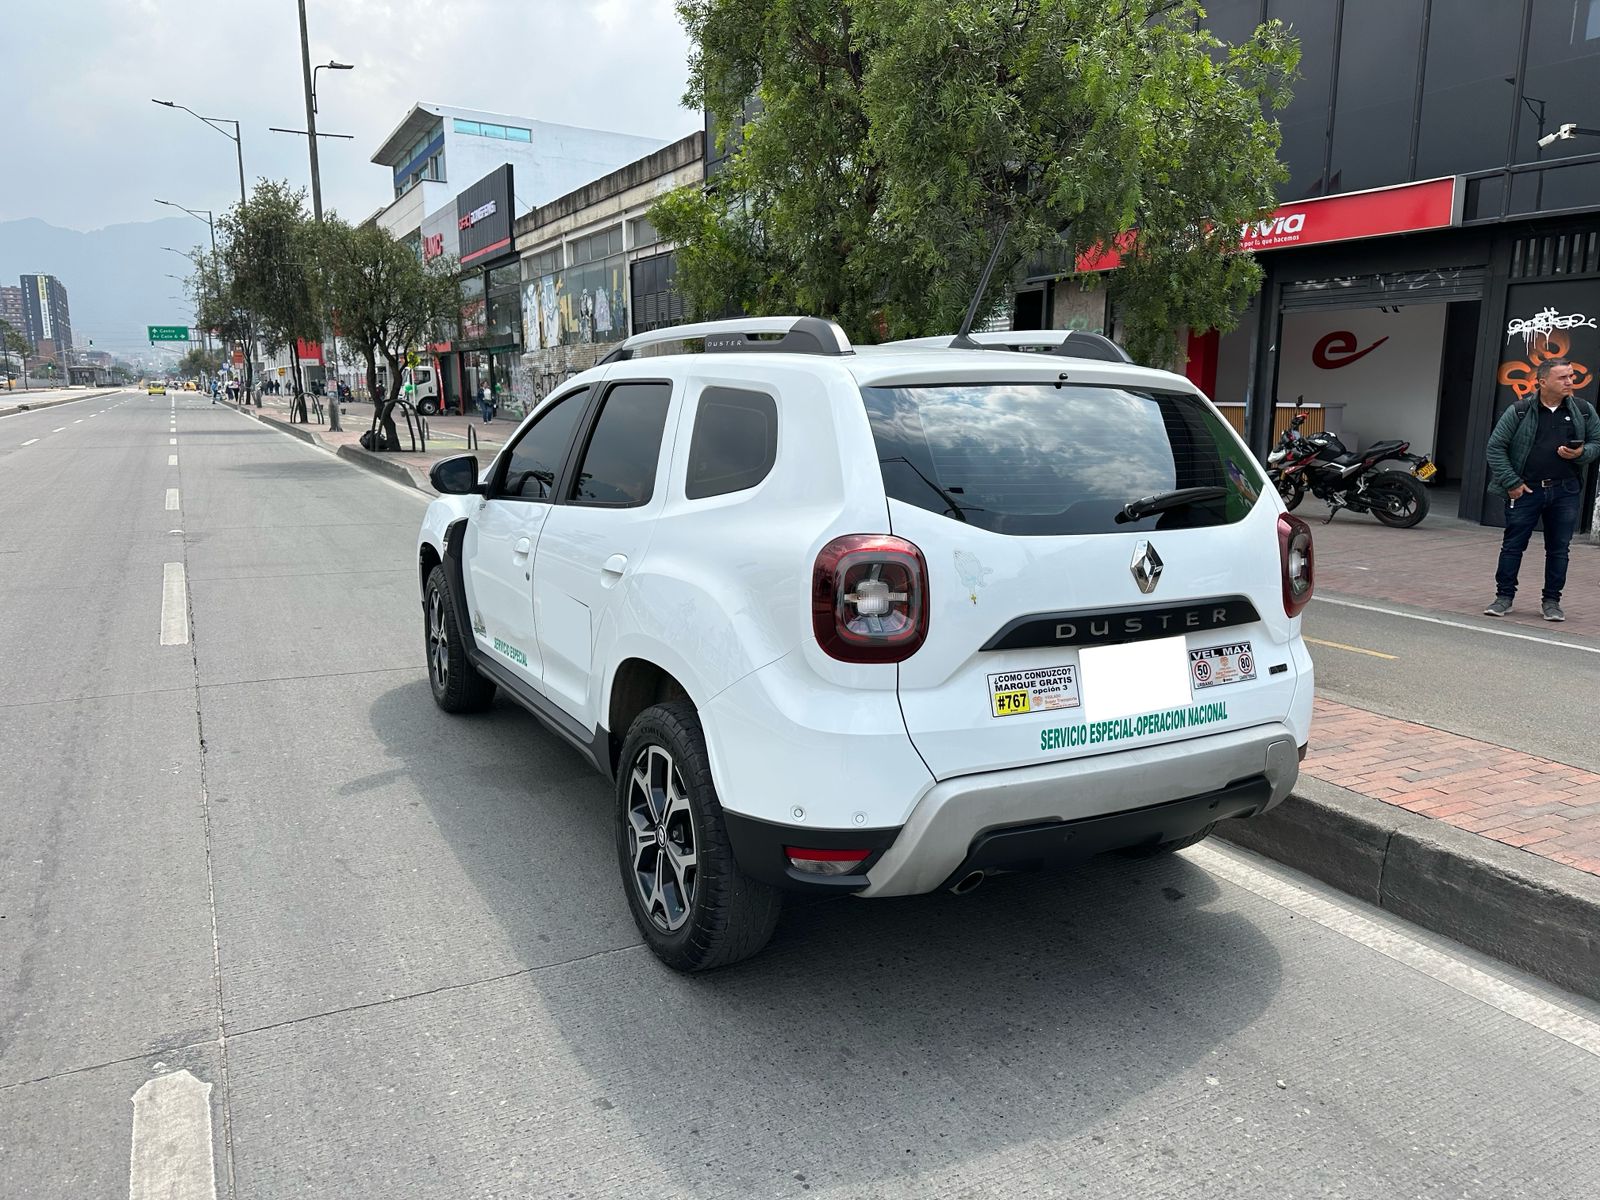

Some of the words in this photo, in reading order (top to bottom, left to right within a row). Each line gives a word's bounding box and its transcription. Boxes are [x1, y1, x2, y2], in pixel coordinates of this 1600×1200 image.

[1055, 608, 1227, 639] DUSTER
[1192, 650, 1219, 661] VEL
[1222, 644, 1249, 656] MAX
[1197, 664, 1208, 676] 50
[1240, 657, 1249, 669] 80
[994, 673, 1022, 684] ¿COMO
[1024, 668, 1071, 680] CONDUZCO?
[995, 681, 1037, 692] MARQUE
[1039, 676, 1072, 687] GRATIS
[1032, 686, 1060, 695] opción
[998, 693, 1026, 710] #767
[1040, 724, 1087, 751] SERVICIO
[1089, 708, 1186, 744] ESPECIAL-OPERACION
[1187, 701, 1228, 726] NACIONAL
